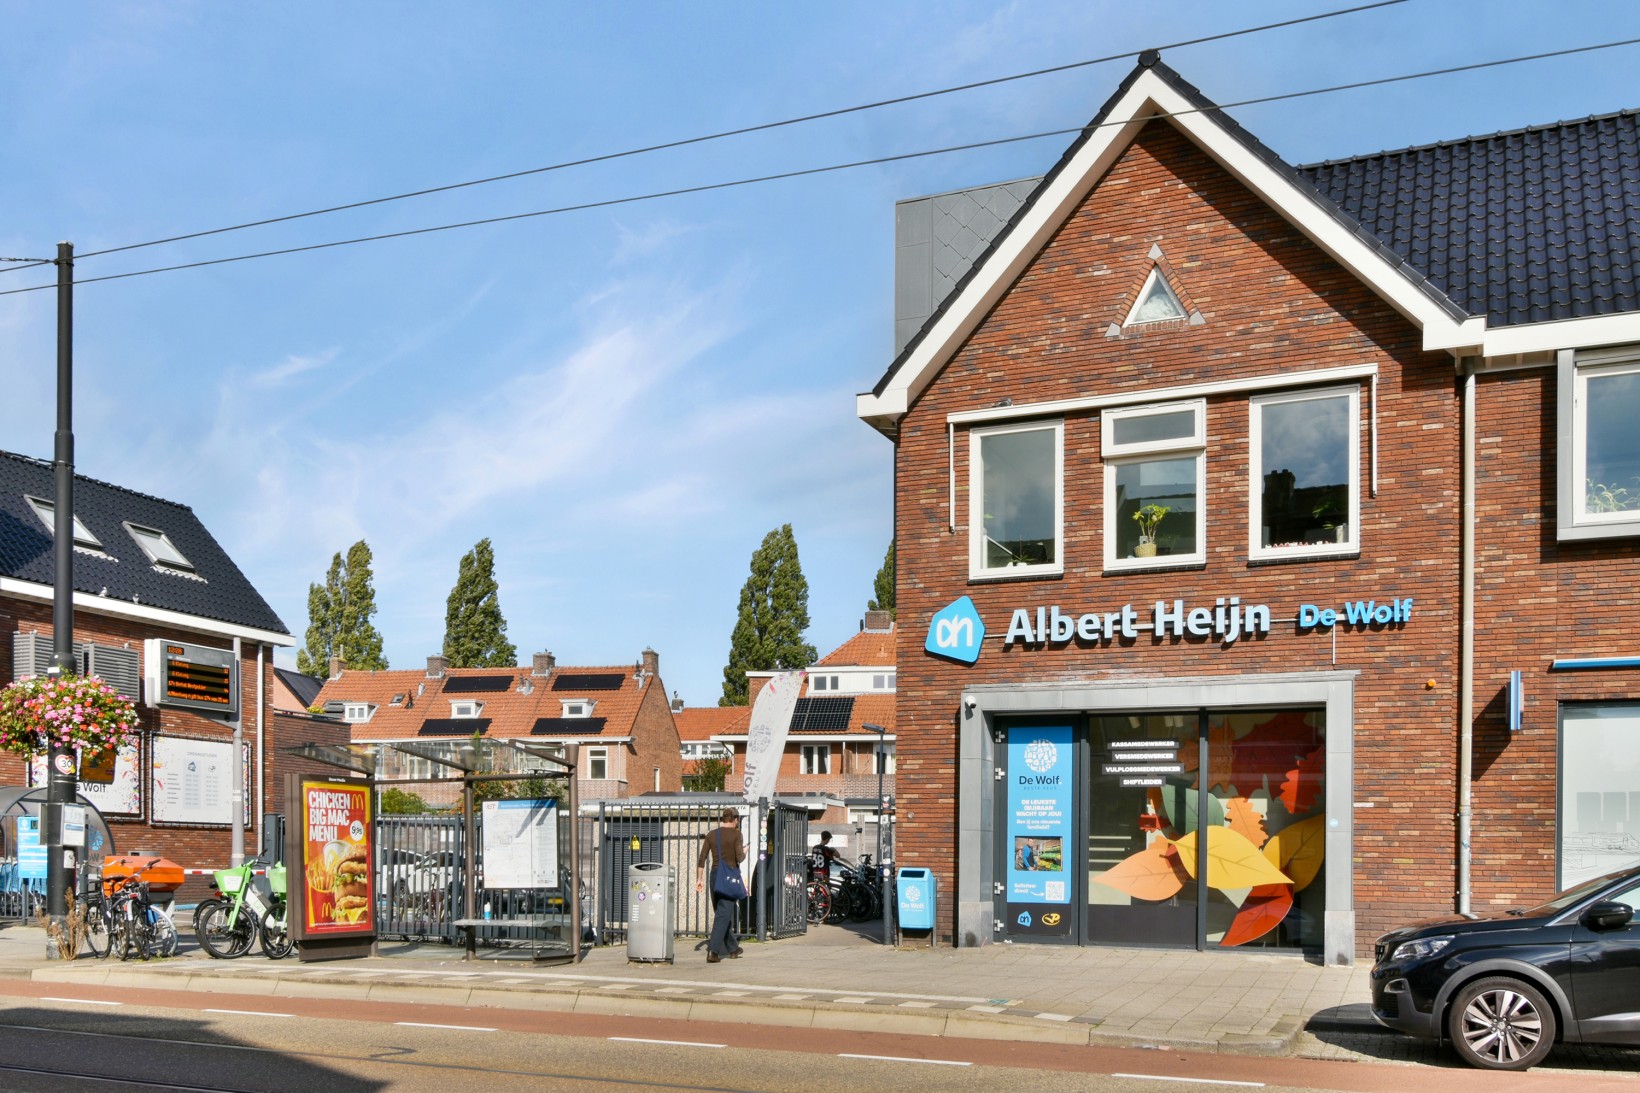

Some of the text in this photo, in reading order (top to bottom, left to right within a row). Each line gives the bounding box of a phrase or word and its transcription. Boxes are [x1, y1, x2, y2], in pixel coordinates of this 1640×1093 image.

[1004, 596, 1270, 644] Albert Heijn
[1300, 598, 1414, 627] De Wolf
[1019, 776, 1033, 785] De
[309, 791, 350, 809] CHICKEN
[310, 808, 349, 826] BIG MAC
[310, 826, 338, 841] MENU
